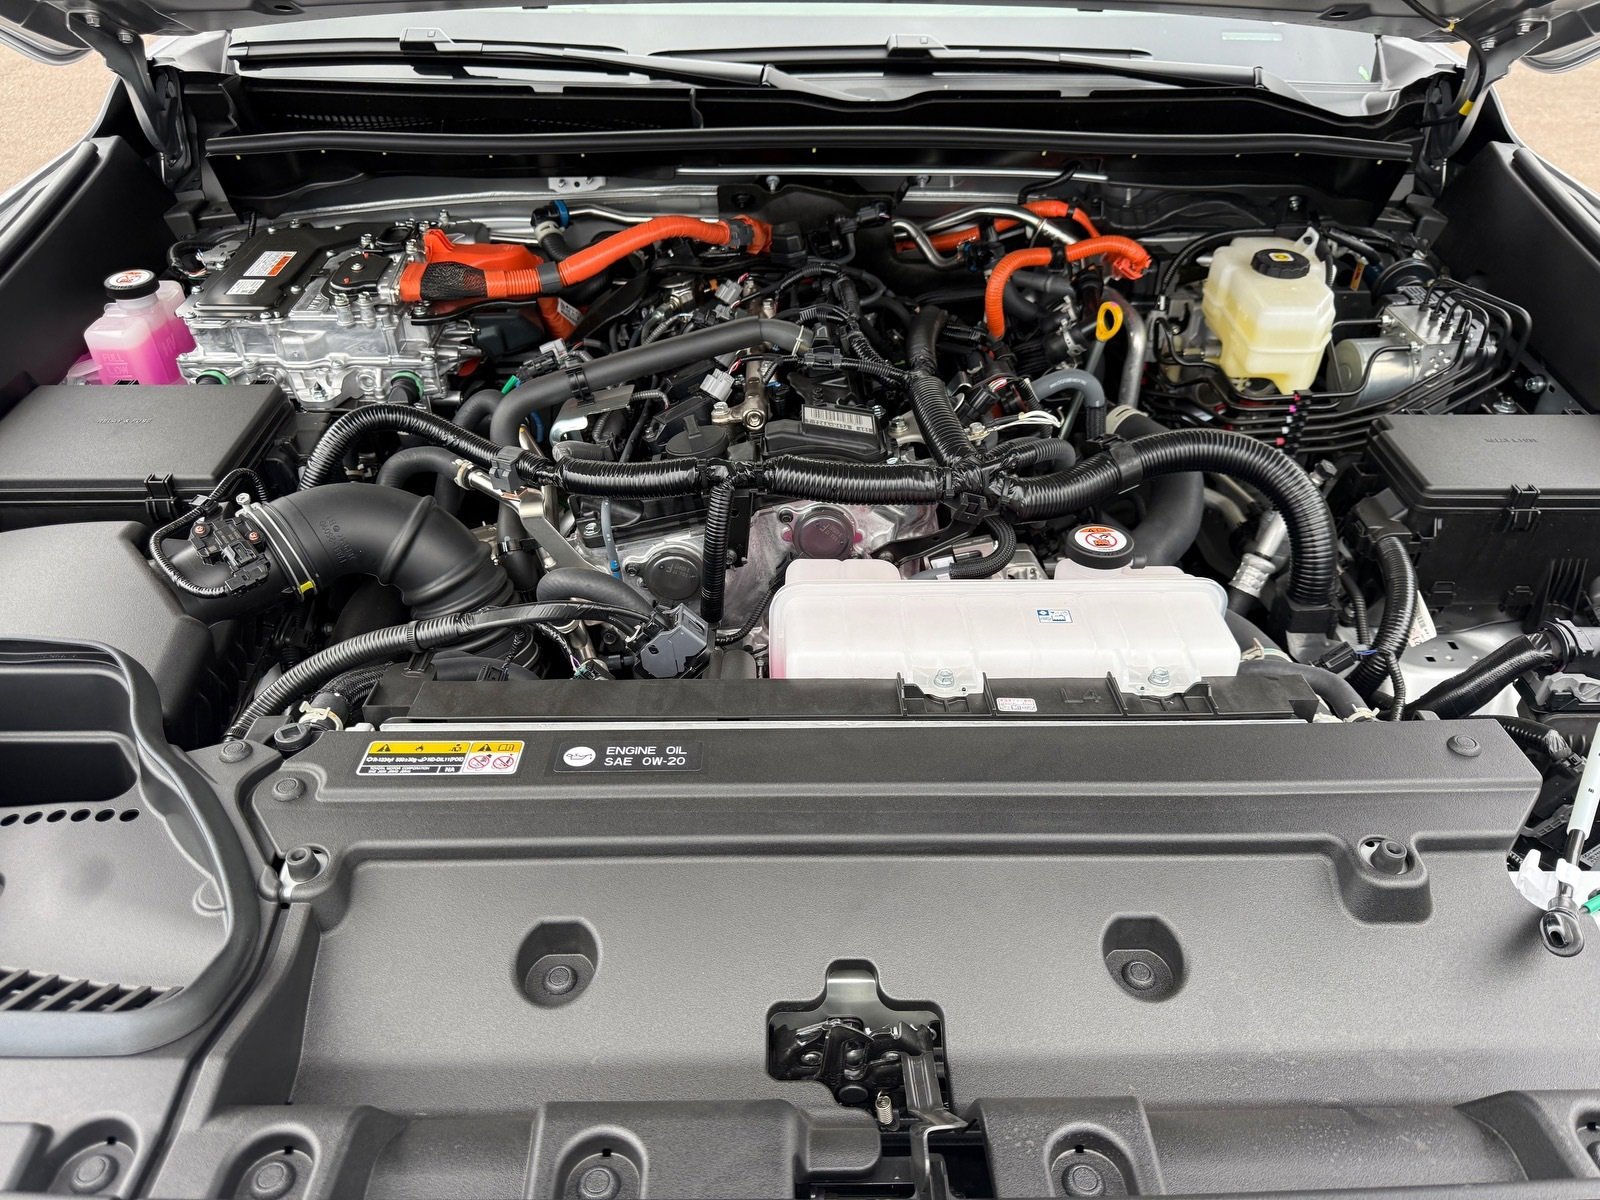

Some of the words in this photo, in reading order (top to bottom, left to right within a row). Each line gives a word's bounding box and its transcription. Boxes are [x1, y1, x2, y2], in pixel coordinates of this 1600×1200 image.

[606, 746, 657, 755] ENGINE
[665, 746, 688, 755] OIL
[603, 757, 634, 766] SAE
